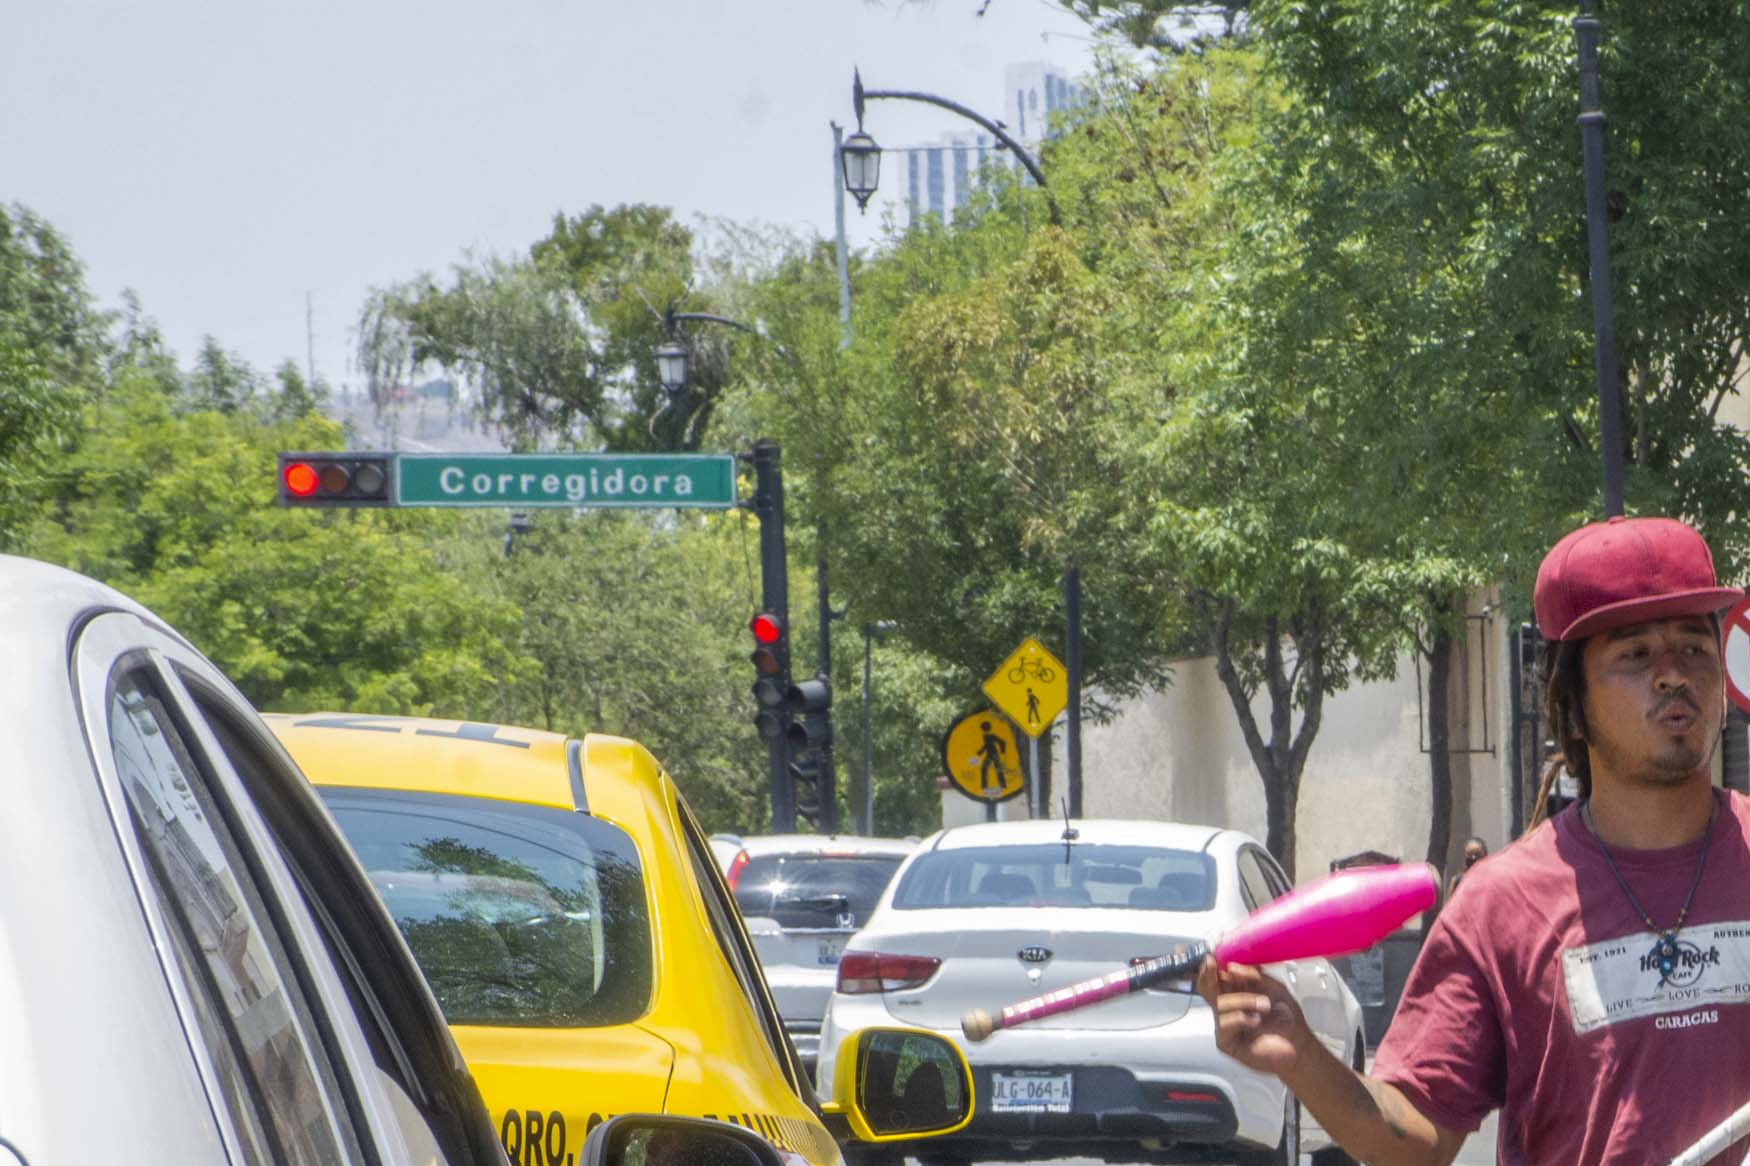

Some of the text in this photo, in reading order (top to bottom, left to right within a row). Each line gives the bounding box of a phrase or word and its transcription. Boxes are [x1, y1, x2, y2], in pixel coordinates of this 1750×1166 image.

[439, 466, 693, 501] Corregidora
[1023, 948, 1047, 961] KIA
[1680, 945, 1721, 968] Rock
[1606, 999, 1634, 1013] LIVE
[1668, 988, 1701, 1001] LOVE
[1655, 1010, 1719, 1030] CARACAS
